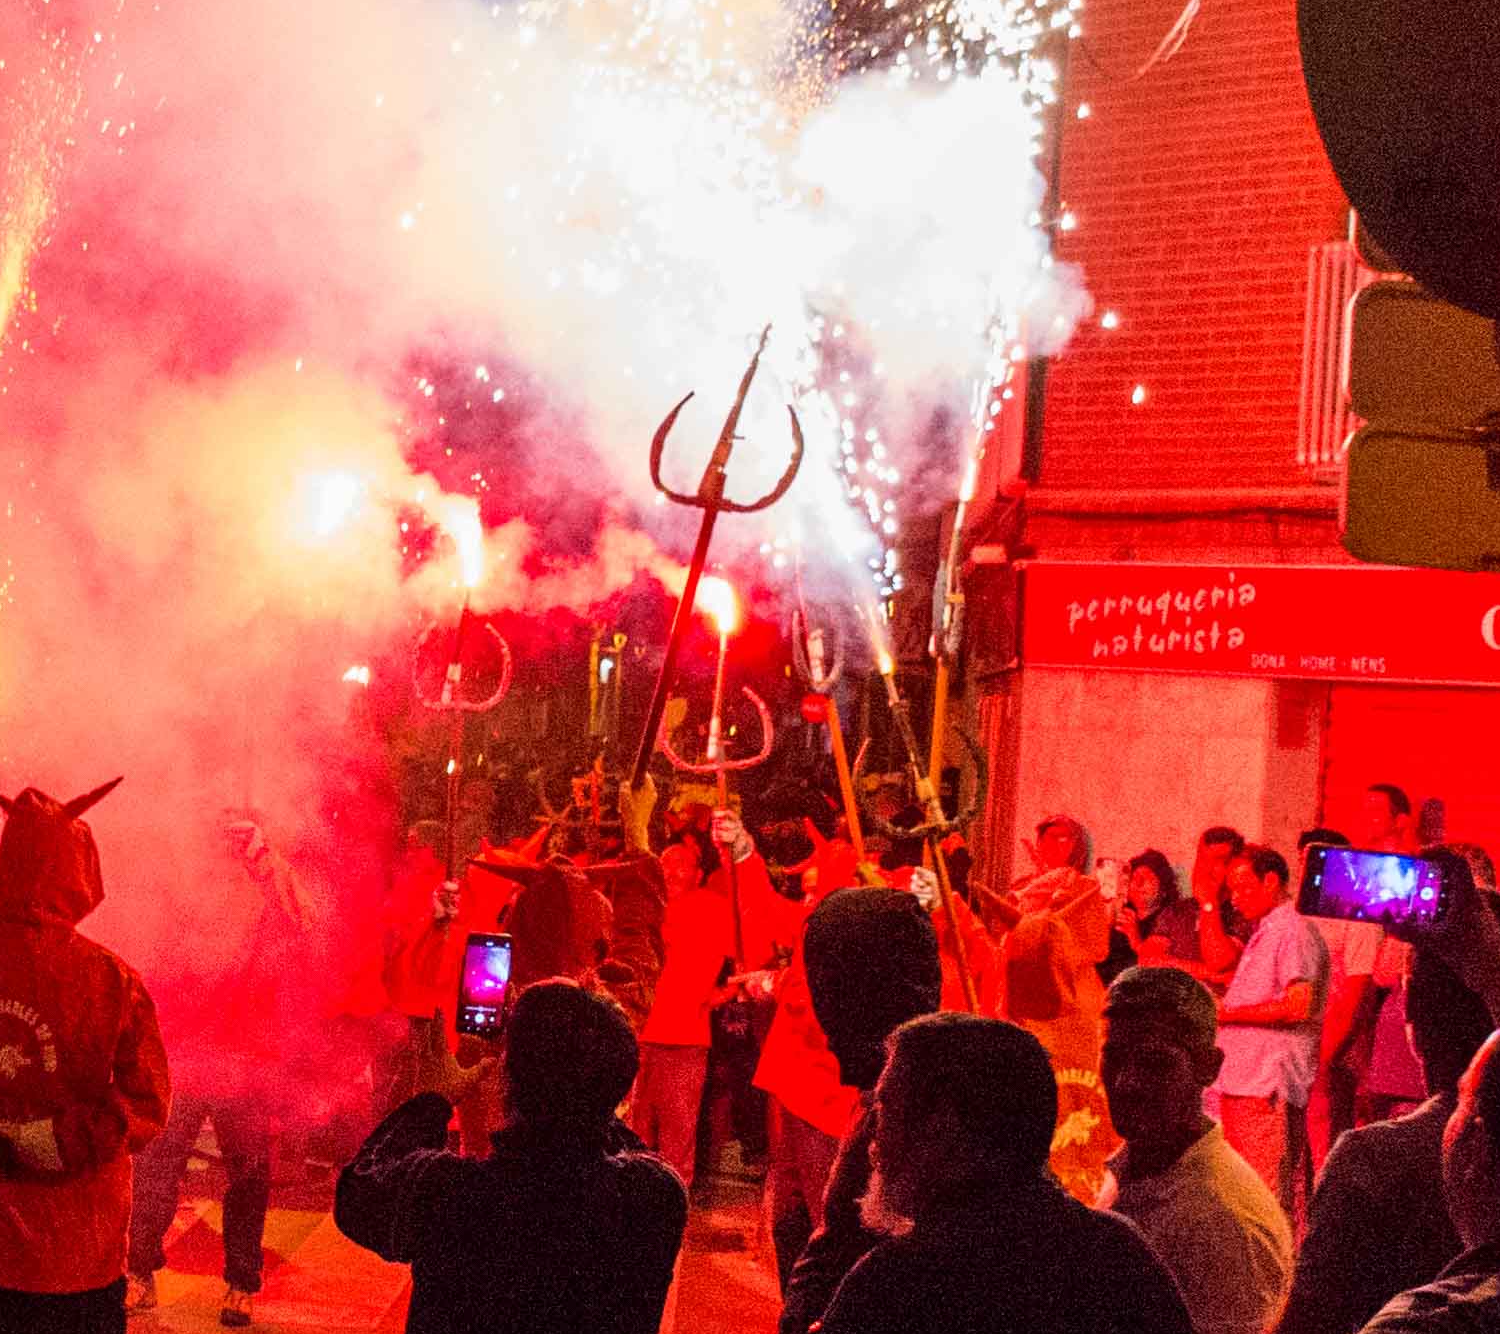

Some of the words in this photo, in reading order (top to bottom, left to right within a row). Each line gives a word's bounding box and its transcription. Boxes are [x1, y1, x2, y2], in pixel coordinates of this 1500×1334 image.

[1066, 570, 1257, 634] perruqueria
[1092, 614, 1246, 659] naturista
[1250, 652, 1287, 669] DONA
[1299, 654, 1338, 672] HOME
[1350, 656, 1387, 674] NENS
